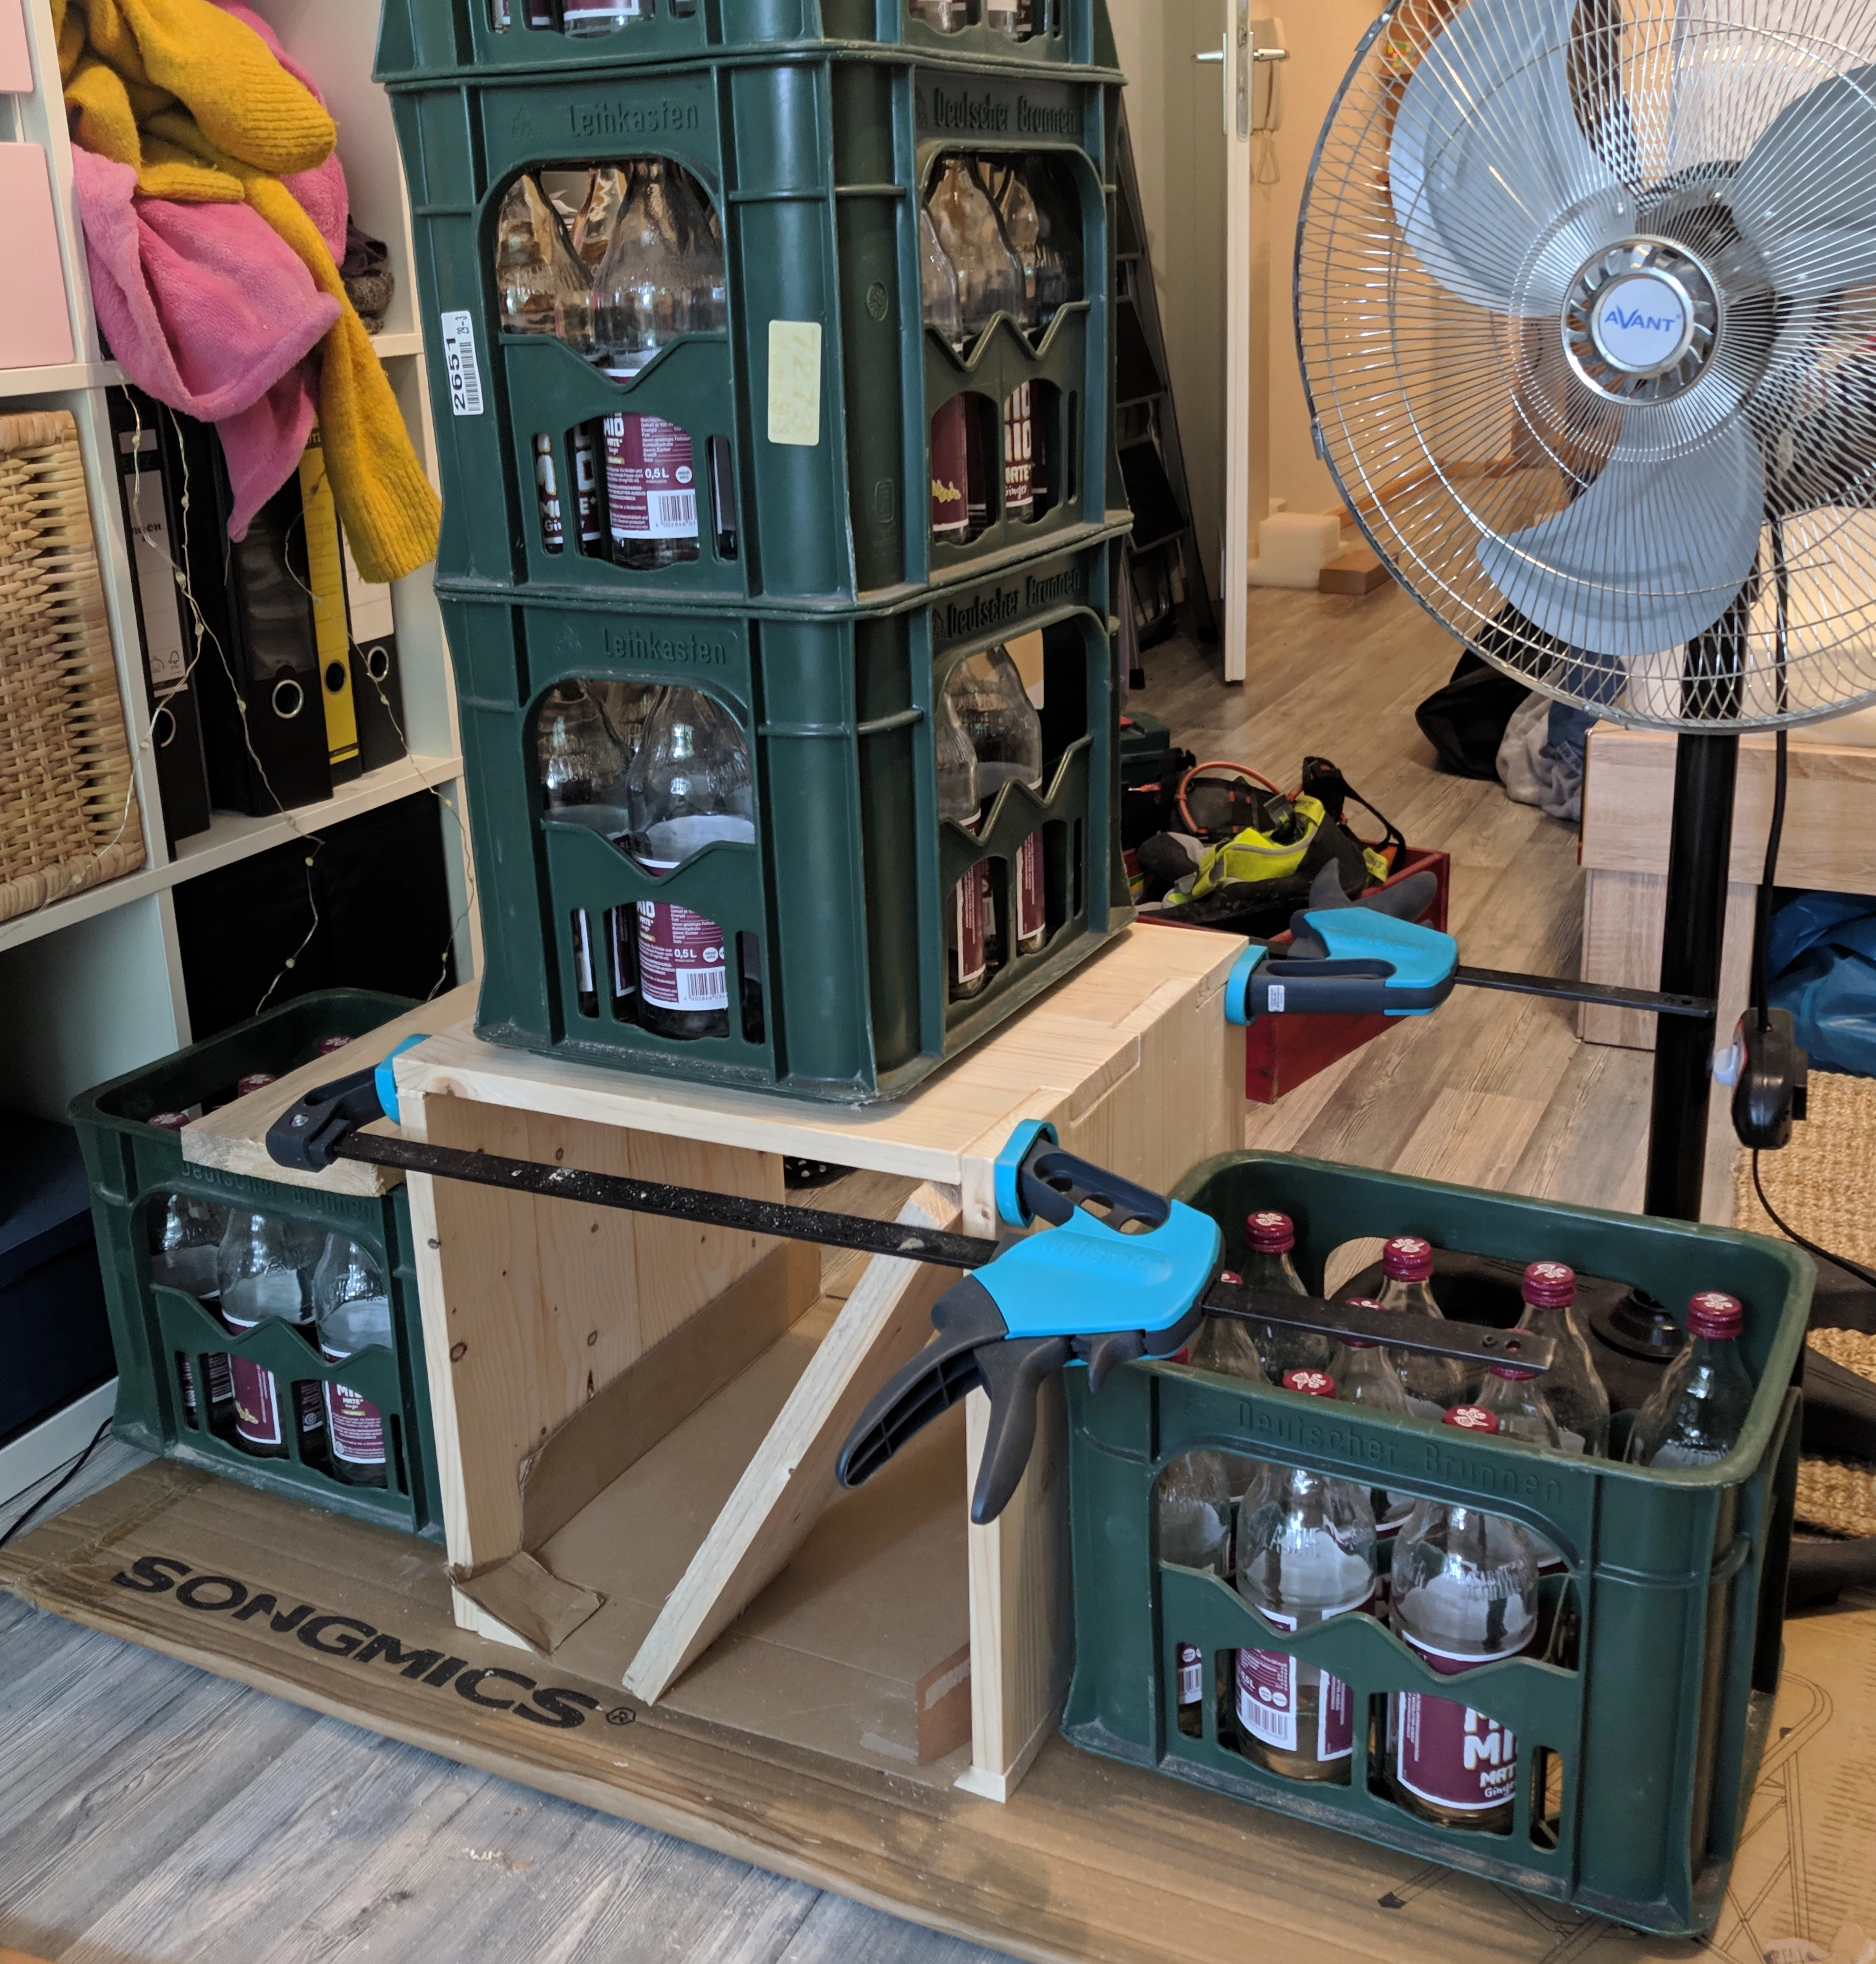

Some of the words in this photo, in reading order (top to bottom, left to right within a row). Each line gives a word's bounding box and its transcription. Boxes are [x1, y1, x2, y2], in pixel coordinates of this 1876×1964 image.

[569, 100, 699, 137] Leihkasten
[934, 88, 1010, 131] Deutscher
[1604, 305, 1675, 332] AVANT
[446, 338, 467, 410] 2651
[645, 468, 661, 480] 0,5
[662, 468, 669, 478] L
[947, 586, 1019, 638] Deutscher
[1025, 568, 1080, 608] Brunnen
[604, 627, 726, 665] Leihkasten
[674, 949, 688, 959] 0,5
[690, 949, 697, 958] L
[1239, 1400, 1398, 1467] Deutscher
[1425, 1442, 1563, 1497] Brunnen
[112, 1556, 600, 1729] SONGMICS
